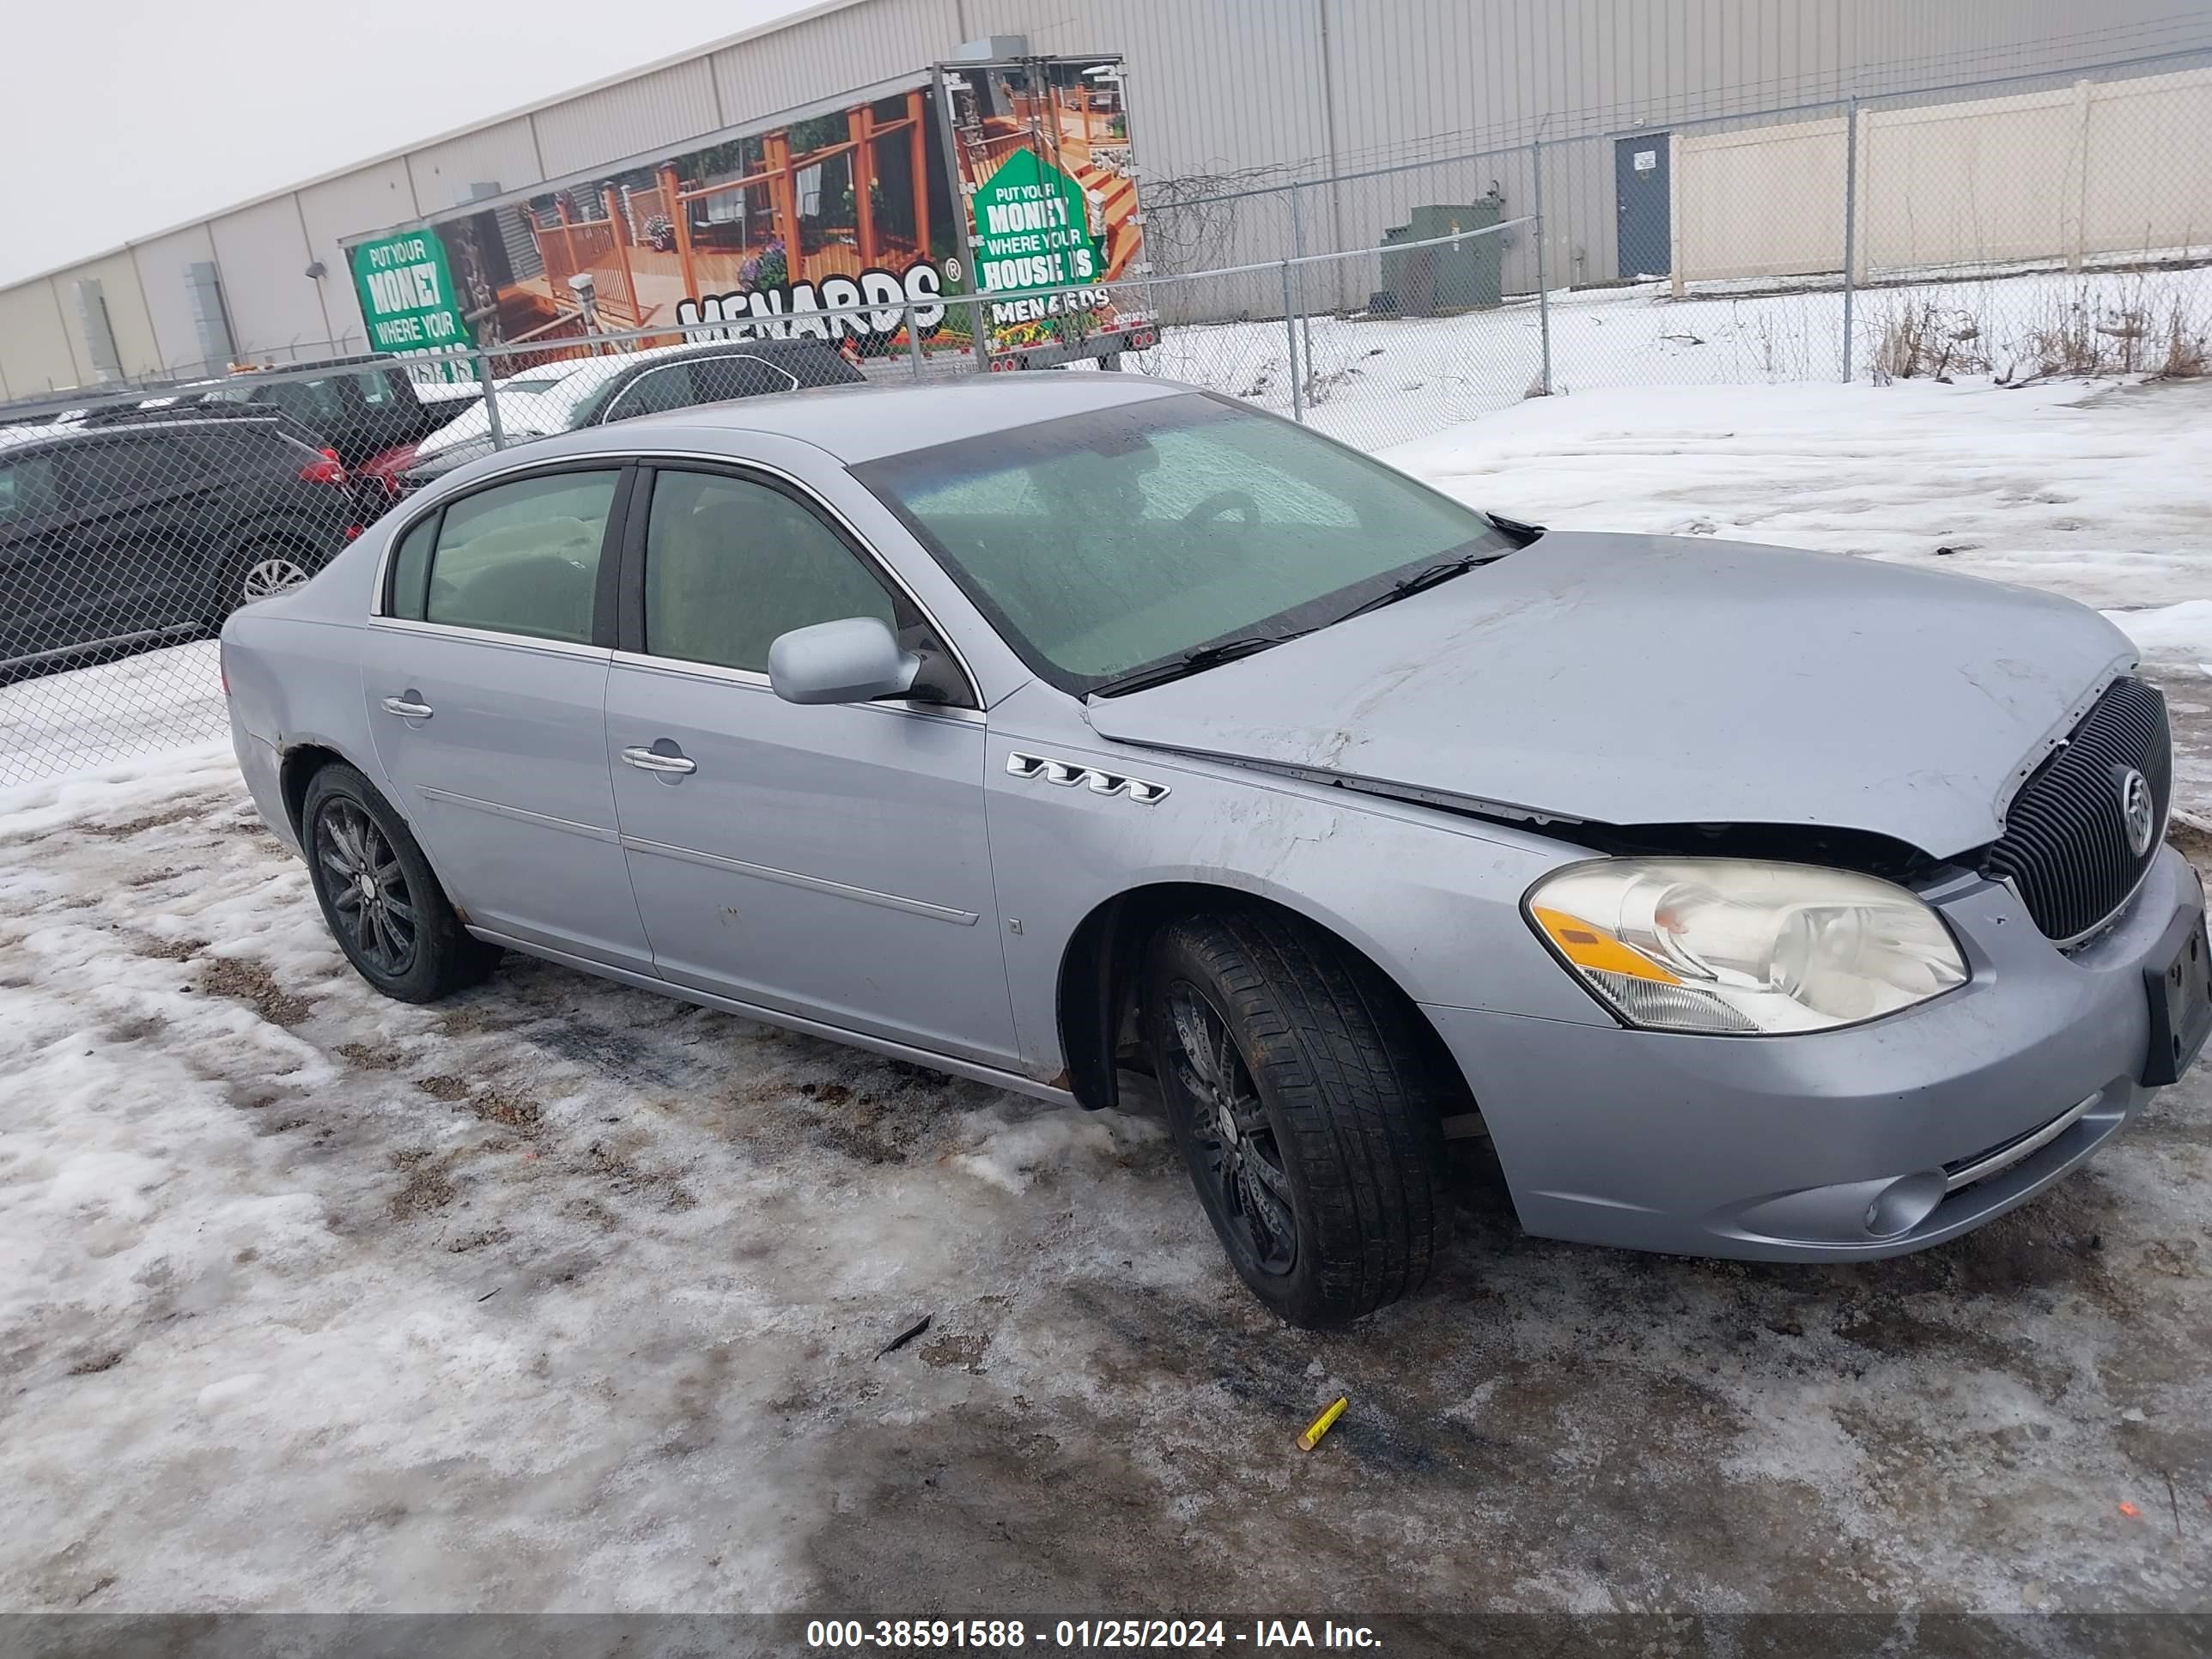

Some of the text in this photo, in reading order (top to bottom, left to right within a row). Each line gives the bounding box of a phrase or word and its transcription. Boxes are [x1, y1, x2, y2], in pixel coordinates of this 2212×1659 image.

[995, 184, 1054, 203] PUT YOUR
[986, 197, 1070, 234] MONEY
[369, 240, 426, 269] PUT YOUR
[986, 228, 1082, 256] WHERE YOUR
[366, 262, 441, 314] MONEY
[982, 250, 1092, 291] HOUSE IS
[678, 262, 946, 344] MENARDS
[990, 287, 1111, 325] MENARDS
[375, 312, 455, 344] WHERE YOUR
